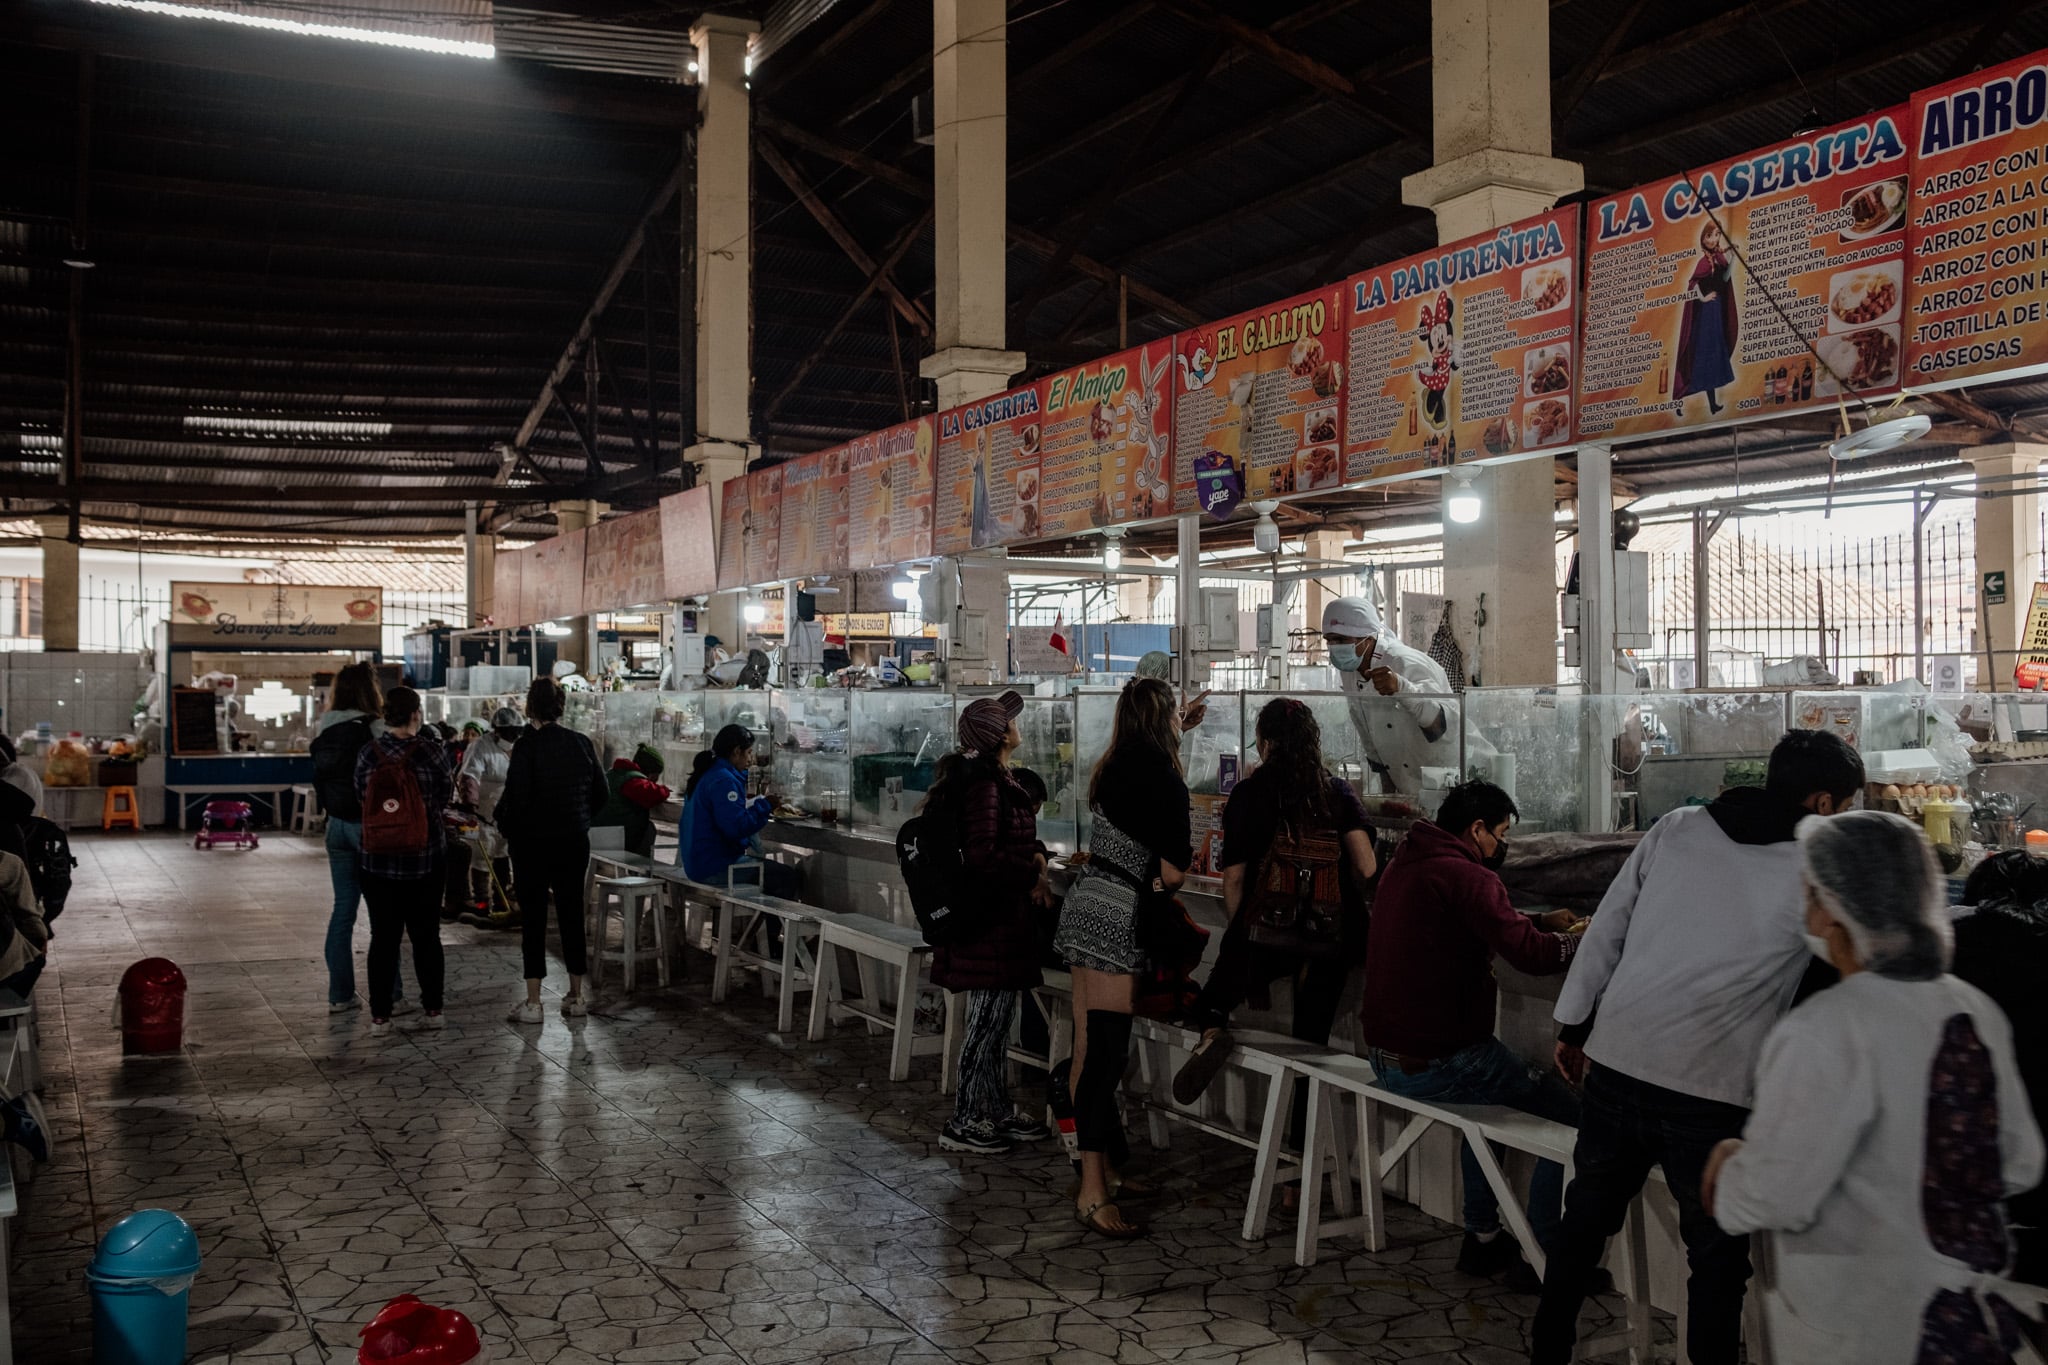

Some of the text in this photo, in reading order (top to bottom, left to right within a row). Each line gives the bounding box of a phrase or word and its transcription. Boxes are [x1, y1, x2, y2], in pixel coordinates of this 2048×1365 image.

[1921, 69, 2048, 155] ARRO
[1599, 120, 1903, 239] LA CASERITA
[1916, 162, 1988, 196] -ARROZ
[1994, 148, 2038, 176] CON
[1747, 195, 1807, 218] -RICE WITH EGG
[1915, 192, 1987, 226] -ARROZ
[1992, 189, 2005, 207] A
[2011, 181, 2035, 202] LA
[1746, 229, 1767, 241] -RICE
[1768, 223, 1788, 235] WITH
[1790, 218, 1806, 230] EGG
[1814, 211, 1830, 224] HOT
[1832, 206, 1851, 219] DOG
[1747, 204, 1815, 230] -CUBA STYLE RICE
[1746, 240, 1766, 252] -RICE
[1767, 234, 1788, 247] WITH
[1789, 230, 1805, 242] EGG
[1813, 217, 1854, 235] AVOCADO
[1914, 223, 1986, 255] -ARROZ
[1992, 210, 2035, 237] CON
[1613, 266, 1627, 275] CON
[1629, 259, 1651, 272] HUEVO
[1658, 248, 1696, 264] SALCHICHA
[1745, 240, 1809, 262] -MIXED EGG RICE
[1770, 265, 1802, 280] JUMPED
[1804, 259, 1825, 272] WITH
[1827, 255, 1844, 266] EGG
[1845, 251, 1858, 262] OR
[1860, 241, 1902, 258] AVOCADO
[1789, 248, 1824, 264] CHICKEN
[1914, 253, 1985, 284] -ARROZ
[1991, 241, 2034, 267] CON
[1356, 223, 1563, 311] LA PARUREÑITA
[1612, 276, 1627, 286] CON
[1628, 270, 1650, 282] HUEVO
[1657, 263, 1677, 274] PALTA
[1612, 286, 1626, 296] CON
[1627, 280, 1650, 292] HUEVO
[1651, 275, 1672, 286] MIXTO
[1743, 279, 1787, 296] -FRIED RICE
[1913, 283, 1984, 313] -ARROZ
[1990, 272, 2034, 298] CON
[1608, 304, 1636, 317] SALTADO
[1637, 302, 1645, 310] C/
[1646, 297, 1669, 308] HUEVO
[1677, 290, 1697, 301] PALTA
[1610, 292, 1644, 306] BROASTER
[1742, 295, 1819, 319] -CHICKEN MILANESE
[1610, 315, 1636, 327] CHAUFA
[1741, 316, 1778, 330] -TORTILLA
[1792, 309, 1808, 320] HOT
[1810, 304, 1828, 316] DOG
[1912, 310, 2007, 342] -TORTILLA
[2013, 302, 2039, 324] DE
[1216, 300, 1325, 361] EL GALLITO
[1619, 337, 1627, 345] DE
[1629, 332, 1650, 343] POLLO
[1740, 325, 1785, 341] -VEGETABLE
[1615, 348, 1624, 356] DE
[1625, 340, 1662, 354] SALCHICHA
[1738, 350, 1775, 364] -SALTADO
[1739, 340, 1767, 352] -SUPER
[1912, 337, 2021, 372] -GASEOSAS
[1614, 358, 1623, 366] DE
[1624, 351, 1660, 364] VERDURAS
[1606, 363, 1651, 378] VEGETARIANO
[1614, 375, 1642, 387] SALTADO
[1047, 367, 1125, 411] El Amigo
[942, 390, 1038, 437] LA CASERITA
[1604, 411, 1618, 419] CON
[1619, 407, 1642, 417] HUEVO
[1643, 404, 1658, 413] MAS
[1659, 400, 1683, 410] QUESO
[1605, 397, 1638, 409] MONTADO
[1736, 398, 1760, 409] -SODA
[1207, 488, 1229, 511] yape
[838, 618, 860, 630] SEGNDOS
